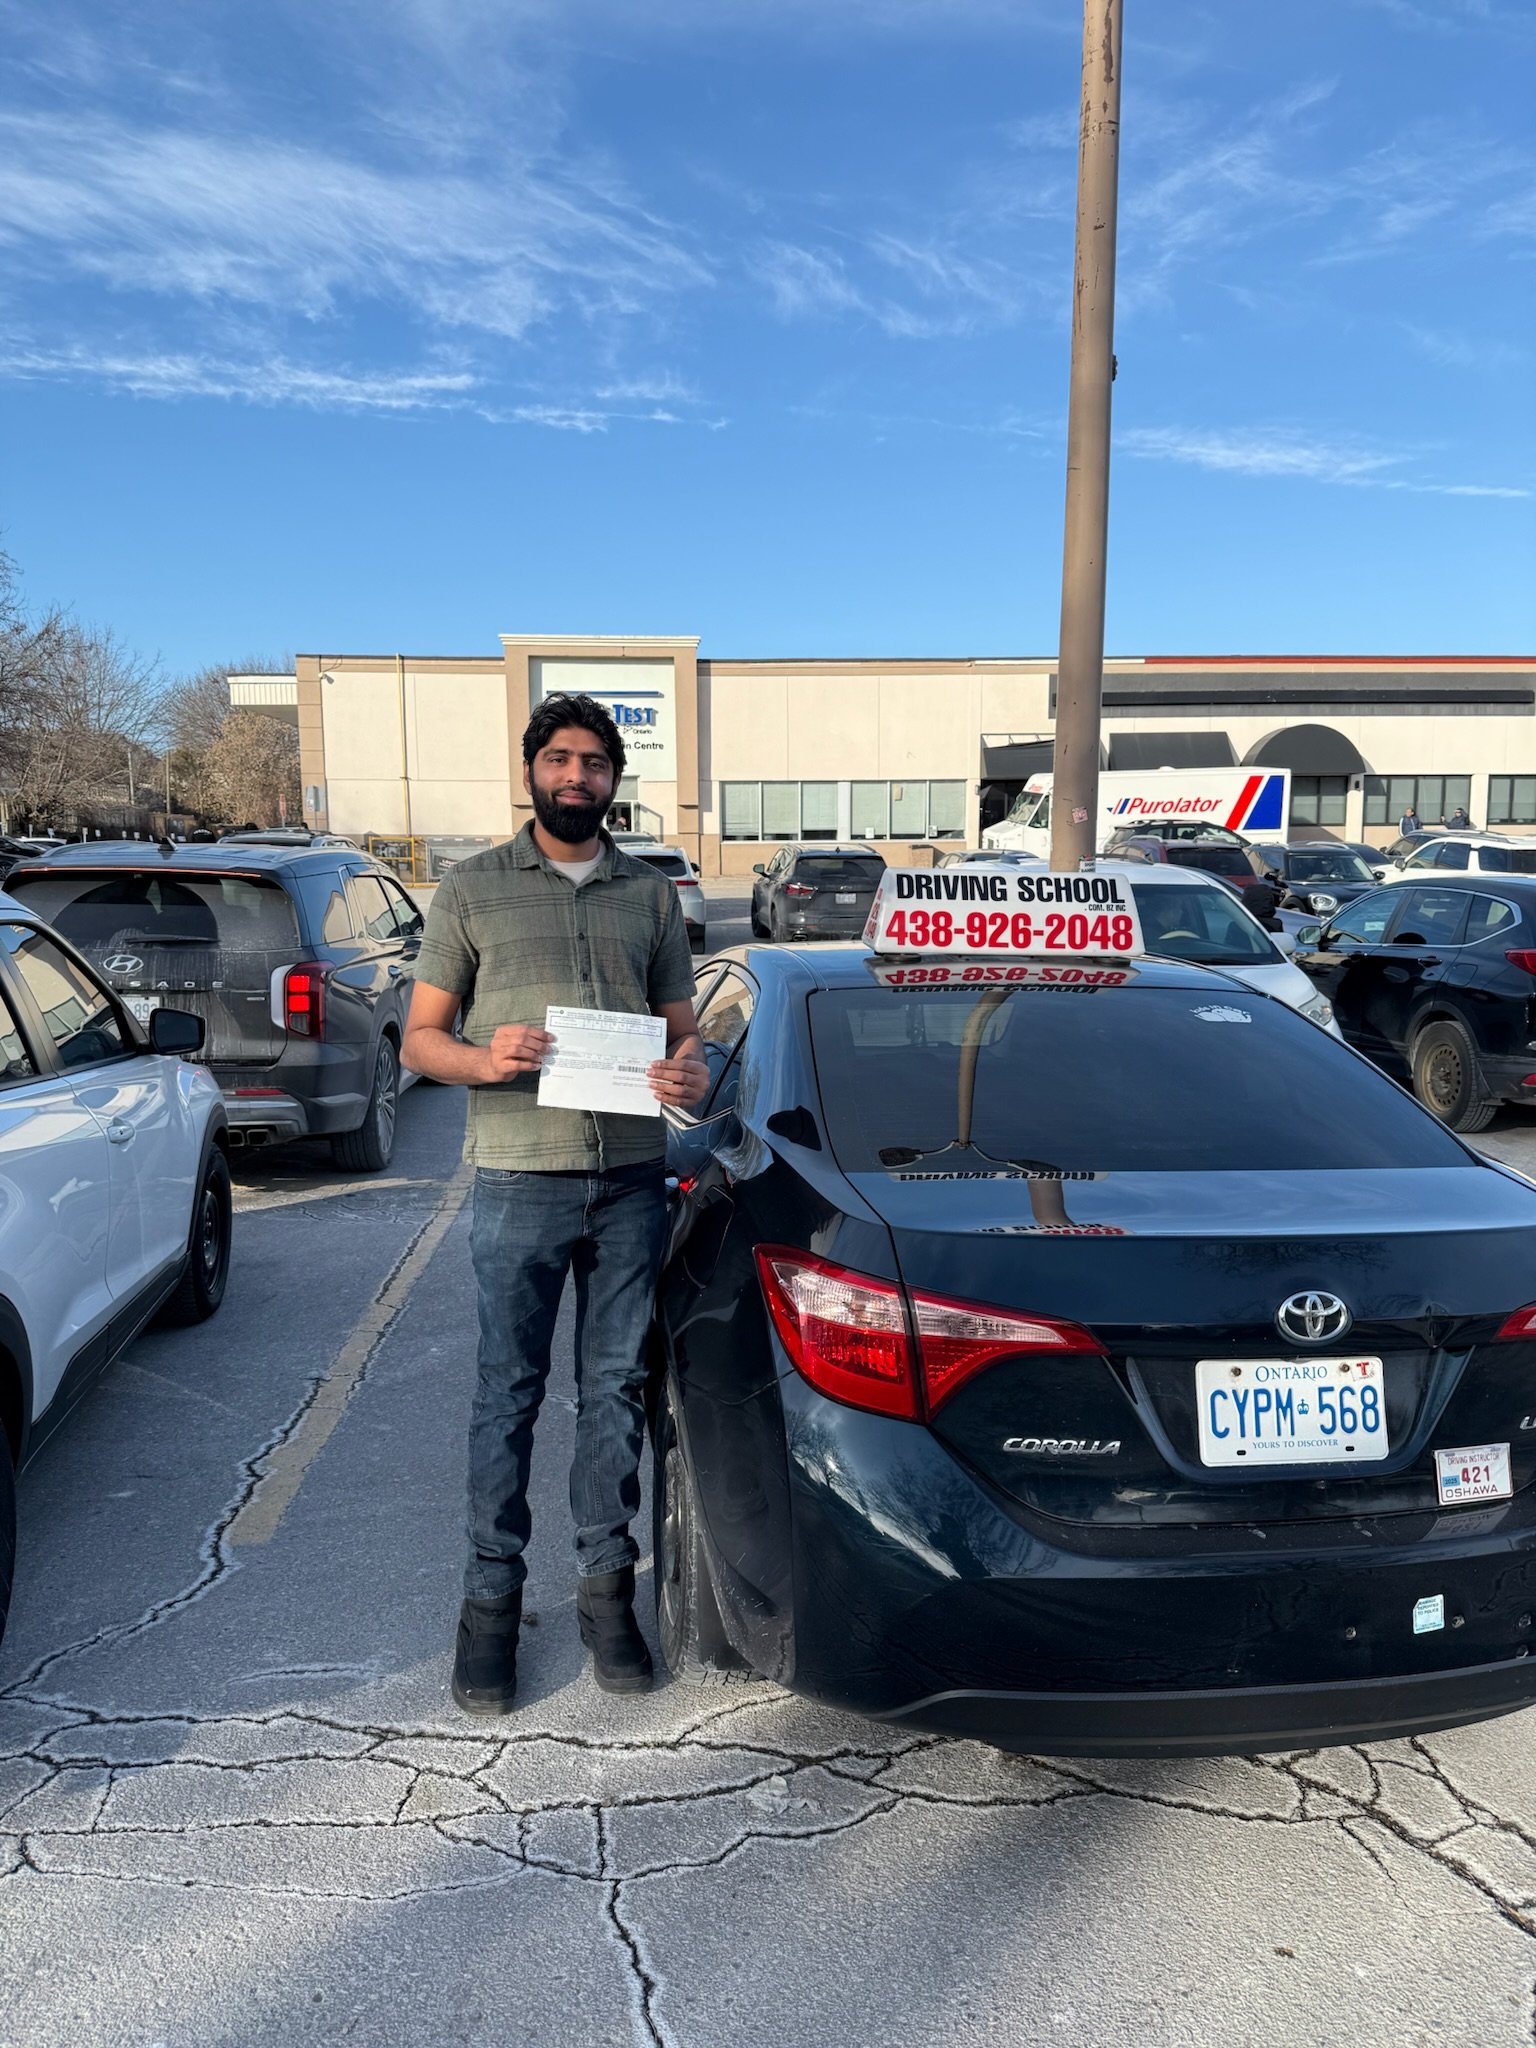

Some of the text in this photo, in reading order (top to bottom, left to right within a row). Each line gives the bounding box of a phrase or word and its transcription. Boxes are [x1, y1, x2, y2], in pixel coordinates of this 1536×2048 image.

[634, 741, 664, 749] Centre
[1127, 797, 1223, 814] Purolator
[896, 873, 1126, 903] DRIVING SCHOOL
[885, 910, 1133, 950] 438-926-2048
[1255, 1366, 1328, 1382] ONTARIO
[1210, 1385, 1380, 1439] CYPM 568
[1003, 1438, 1121, 1454] COROLLA
[1253, 1441, 1280, 1449] YOURS
[1297, 1439, 1338, 1447] DISCOVER
[1447, 1453, 1500, 1465] DRIVING INSTRUCTOR
[1462, 1465, 1490, 1484] 421
[1445, 1484, 1498, 1498] OSHAWA
